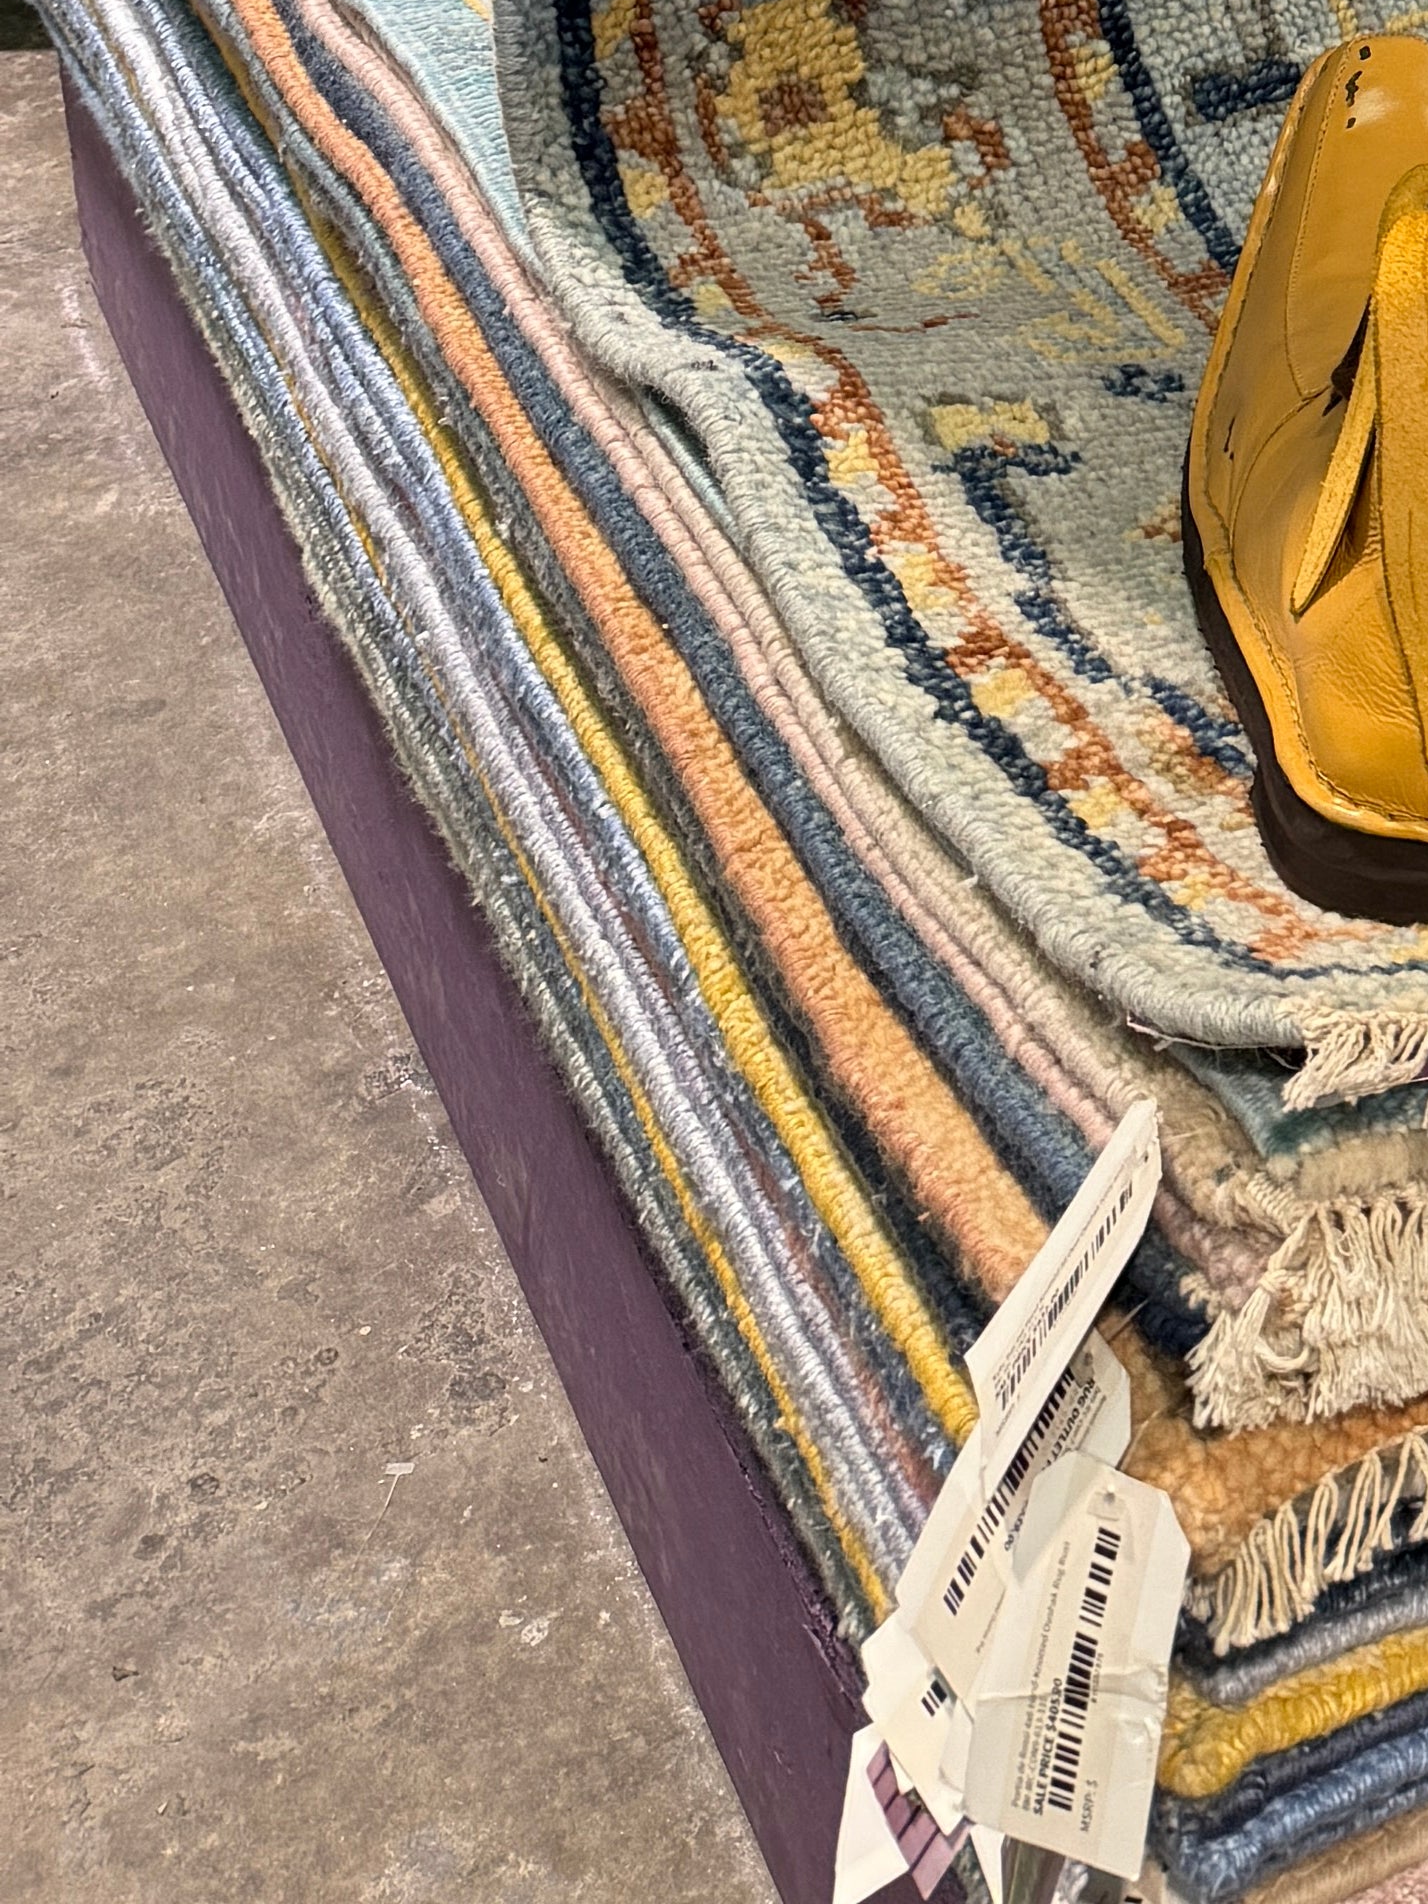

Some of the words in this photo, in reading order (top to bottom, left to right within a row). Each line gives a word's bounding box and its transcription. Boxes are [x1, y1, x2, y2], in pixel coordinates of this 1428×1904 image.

[1077, 1378, 1096, 1410] RUG
[1051, 1407, 1081, 1459] OUTLET
[1039, 1736, 1055, 1779] PRICE
[1033, 1781, 1048, 1815] SALE
